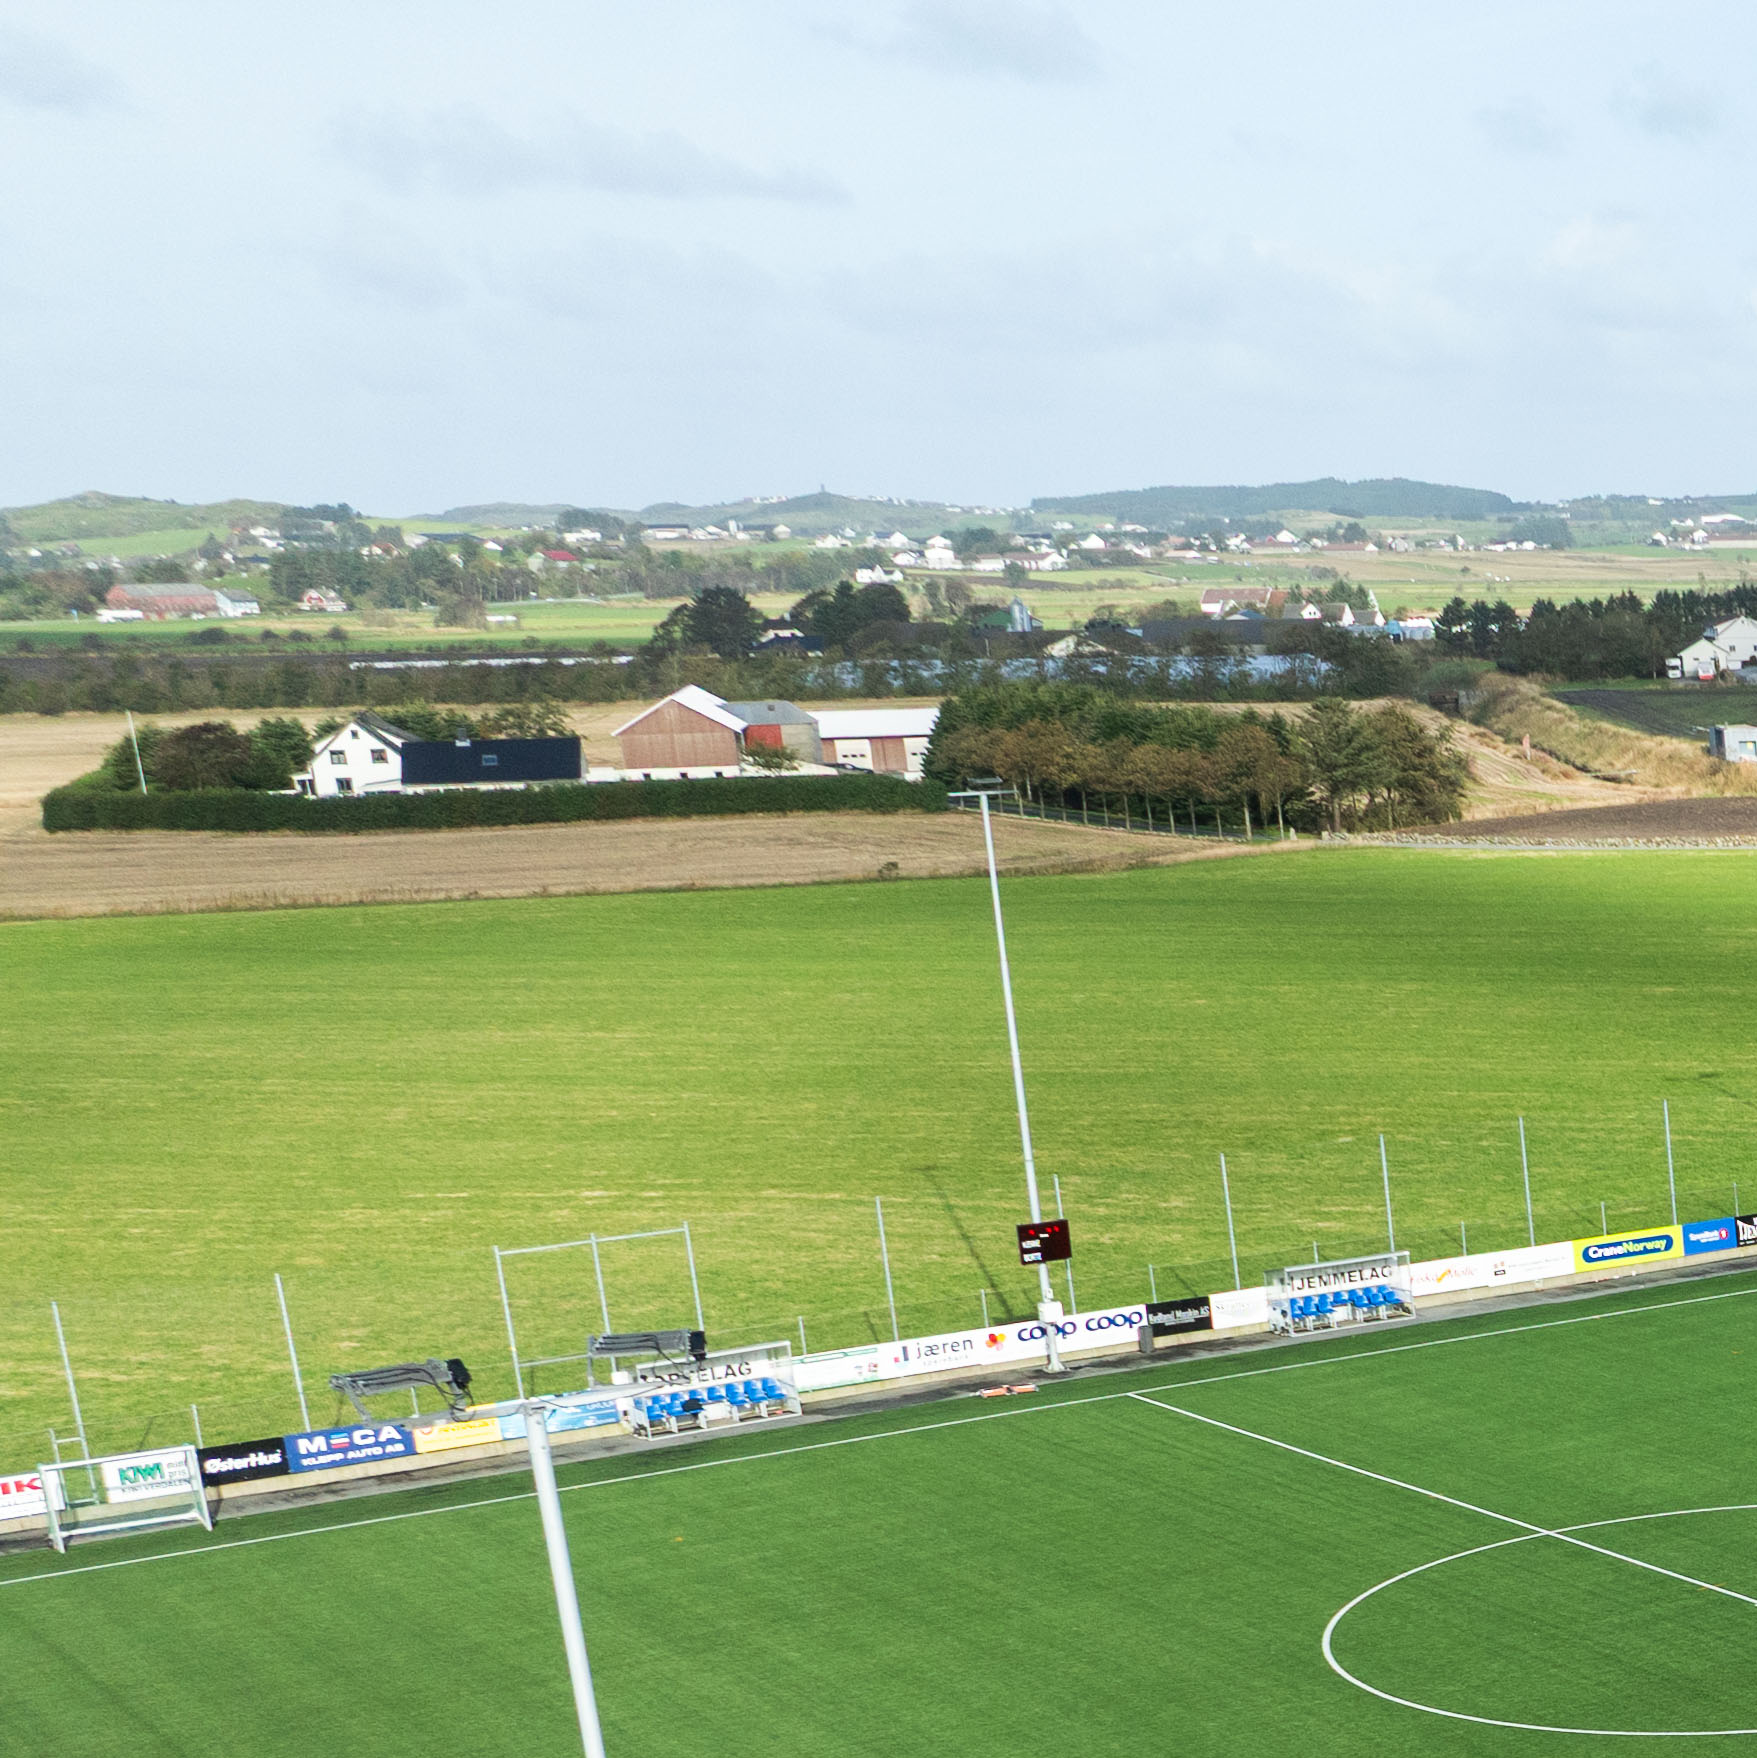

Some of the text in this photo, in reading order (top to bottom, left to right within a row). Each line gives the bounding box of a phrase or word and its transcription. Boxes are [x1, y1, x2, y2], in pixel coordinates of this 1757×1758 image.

[1588, 1238, 1667, 1259] CraneNorway
[1085, 1311, 1143, 1332] coop
[916, 1337, 974, 1359] jæren
[204, 1449, 280, 1474] ØsterHus
[302, 1442, 405, 1467] KLEPP AUTO AS
[118, 1462, 166, 1486] KIWI
